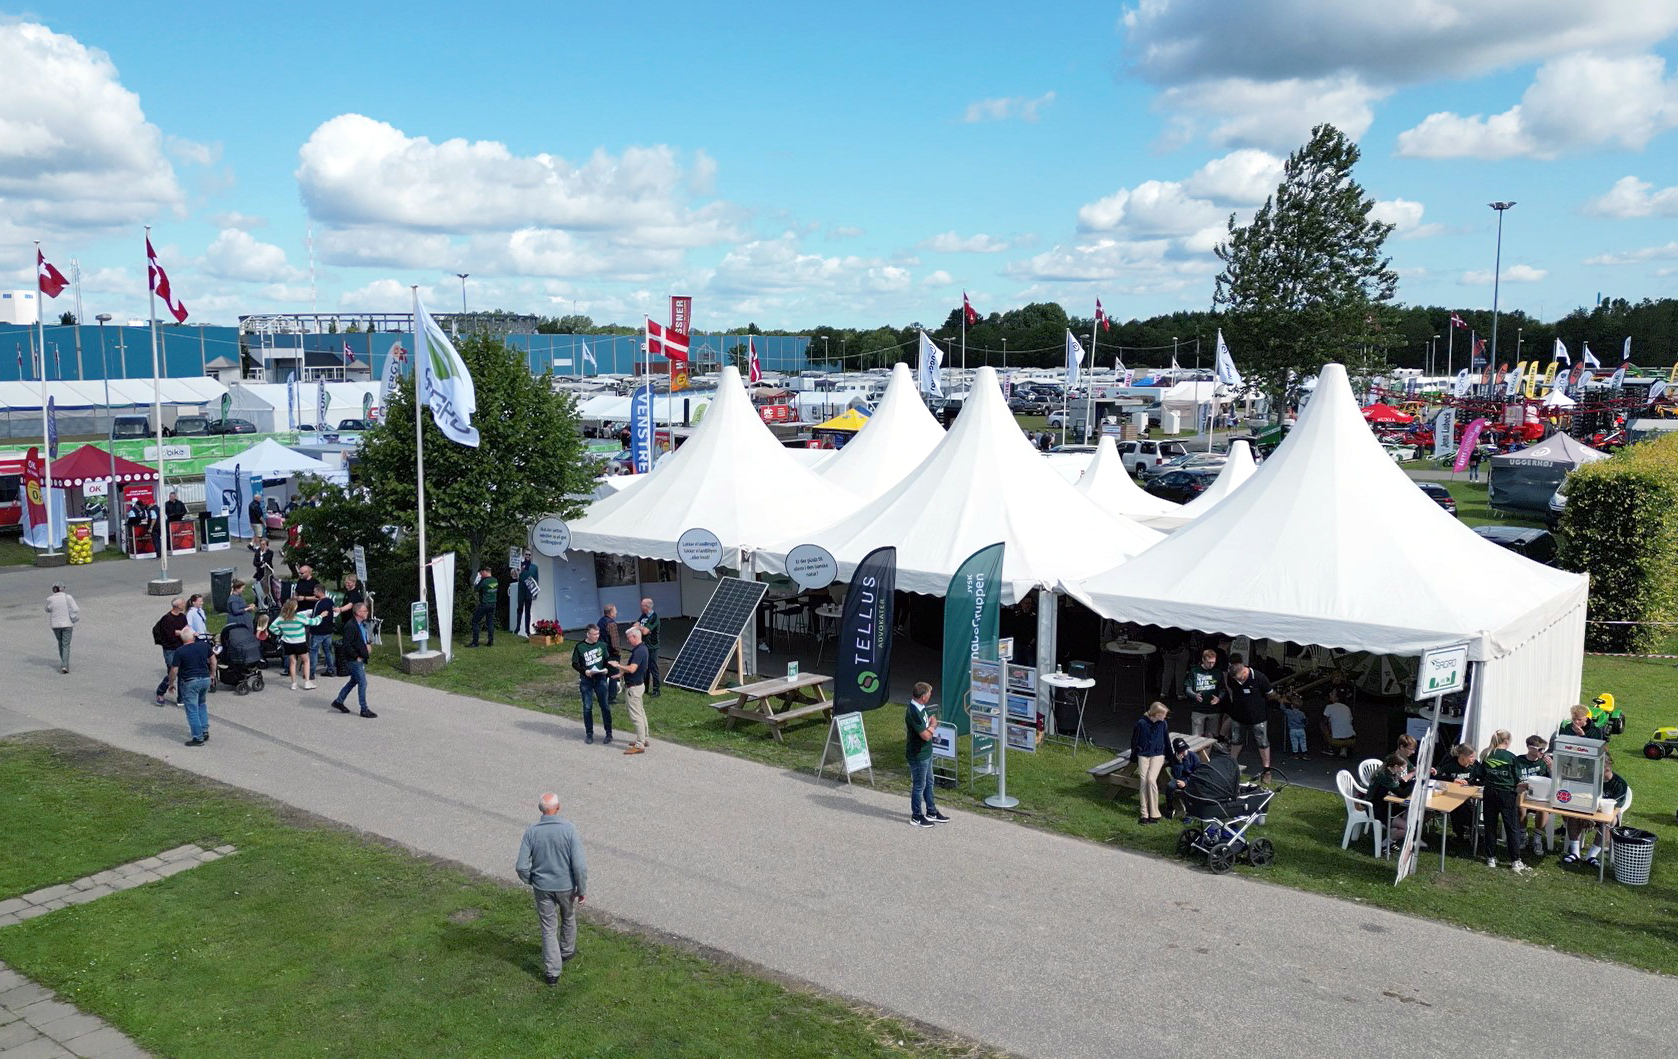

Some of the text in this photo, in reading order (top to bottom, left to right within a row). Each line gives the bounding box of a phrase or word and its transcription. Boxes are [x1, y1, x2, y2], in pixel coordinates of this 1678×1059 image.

[637, 392, 651, 472] VENSTRE
[1509, 458, 1554, 468] UGGERHØJ
[89, 485, 102, 494] OK
[966, 573, 974, 594] JYSK
[854, 576, 876, 665] TELLUS
[877, 598, 885, 649] ADVOKATER
